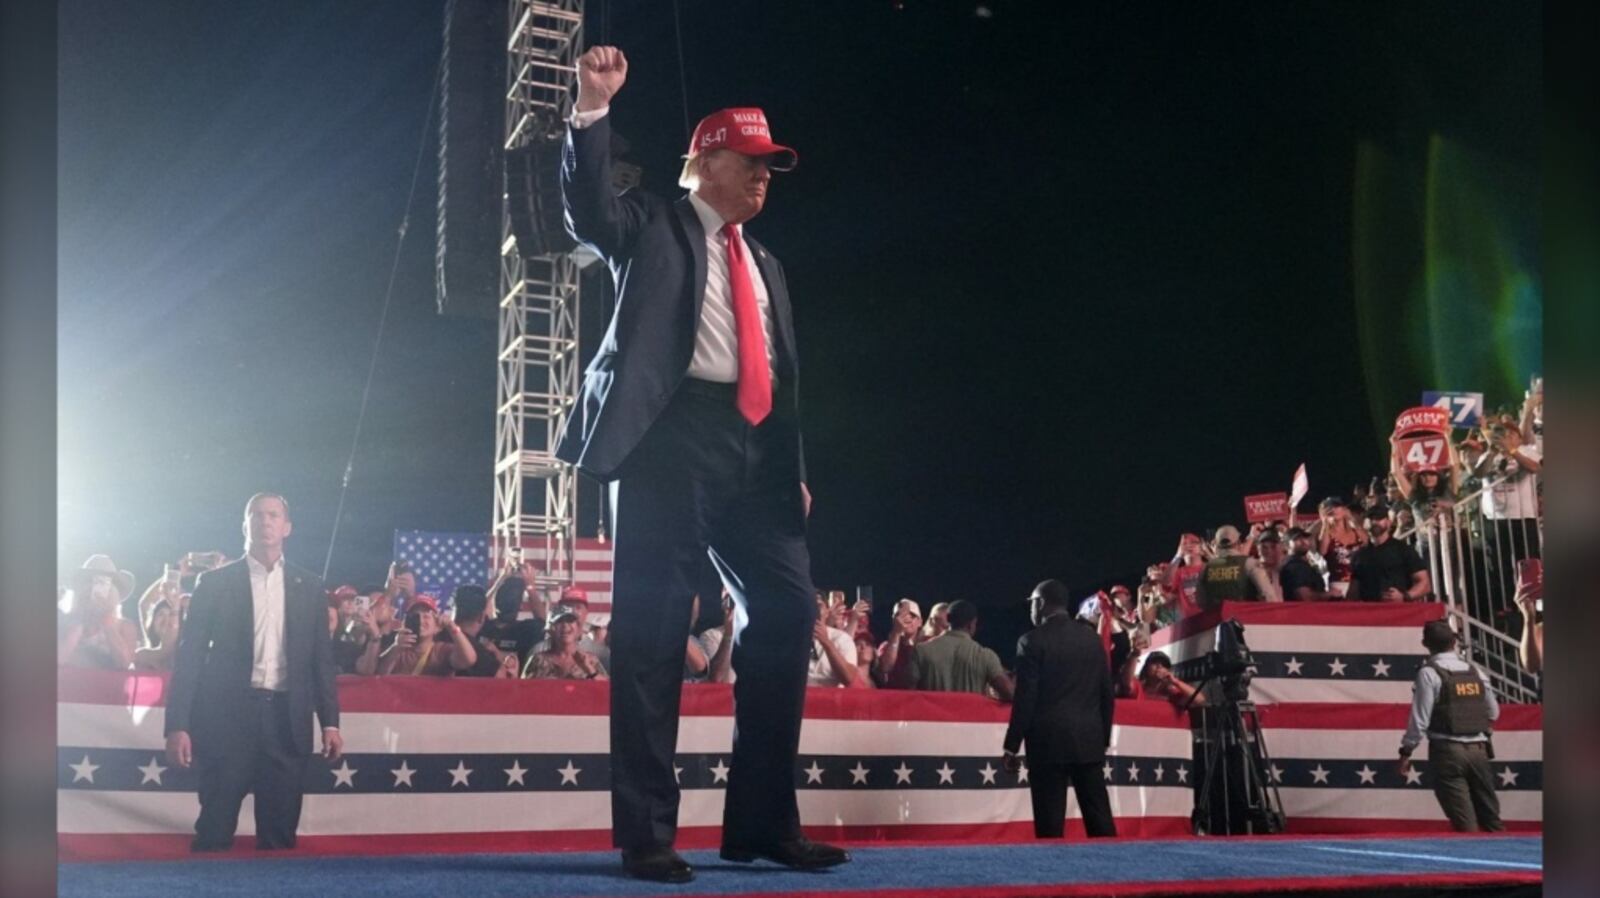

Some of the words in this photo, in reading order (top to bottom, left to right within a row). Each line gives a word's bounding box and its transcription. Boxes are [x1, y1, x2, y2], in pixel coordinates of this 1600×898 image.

[733, 113, 758, 123] MAKE
[1432, 397, 1477, 422] 47
[1406, 439, 1443, 464] 47
[1248, 498, 1285, 508] TRUMP
[1208, 566, 1239, 580] SHERIFF
[1456, 683, 1480, 696] HSI
